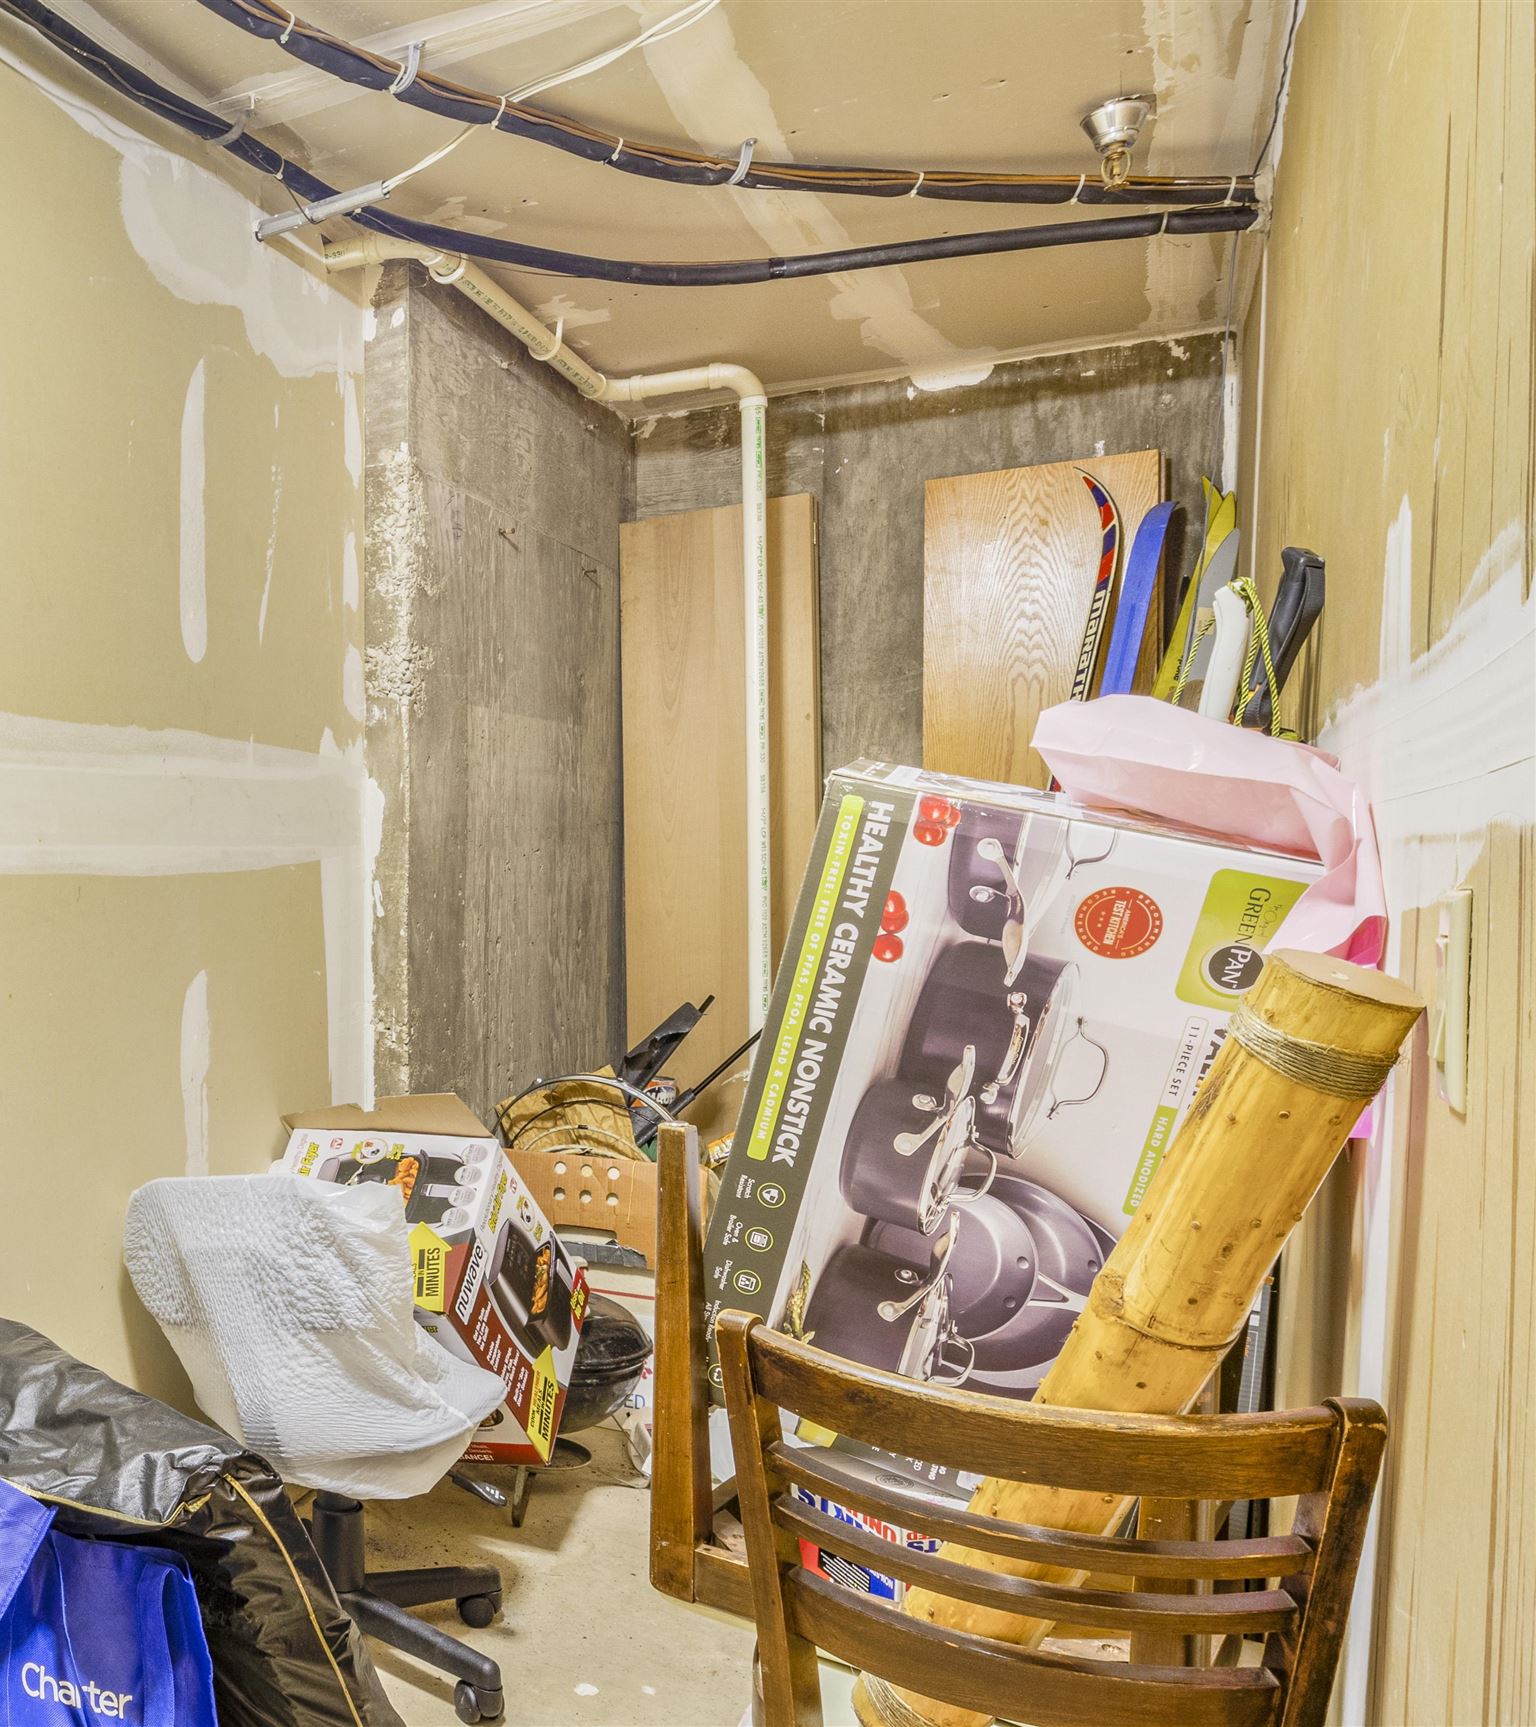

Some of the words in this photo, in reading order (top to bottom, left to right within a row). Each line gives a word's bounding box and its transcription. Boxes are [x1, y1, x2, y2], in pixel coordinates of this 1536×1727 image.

[824, 814, 854, 894] TOXIN-FREE:
[842, 800, 895, 919] HEALTHY
[815, 899, 830, 929] FREE
[809, 934, 821, 952] OF
[796, 953, 815, 989] PFAS,
[808, 922, 859, 1034] CERAMIC
[784, 994, 805, 1030] PFOA,
[776, 1035, 794, 1066] LEAD
[1176, 1026, 1200, 1074] 11-PIECE
[773, 1067, 784, 1078] &
[1168, 1077, 1182, 1097] SET
[756, 1083, 781, 1140] CADMIUM
[771, 1038, 828, 1168] NONSTICK
[1150, 1116, 1169, 1147] HARD
[735, 1174, 748, 1199] Resistant
[744, 1177, 756, 1199] Scratch
[1130, 1150, 1156, 1208] ANODIZED
[722, 1231, 731, 1246] Safe
[733, 1221, 744, 1237] Oven
[425, 1247, 441, 1298] MINUTES
[456, 1243, 485, 1318] nuwave
[713, 1265, 723, 1279] Safe
[719, 1259, 734, 1291] Dishwasher
[535, 1388, 543, 1415] MEALS
[541, 1380, 555, 1441] MINUTES
[20, 1662, 133, 1719] Charter
